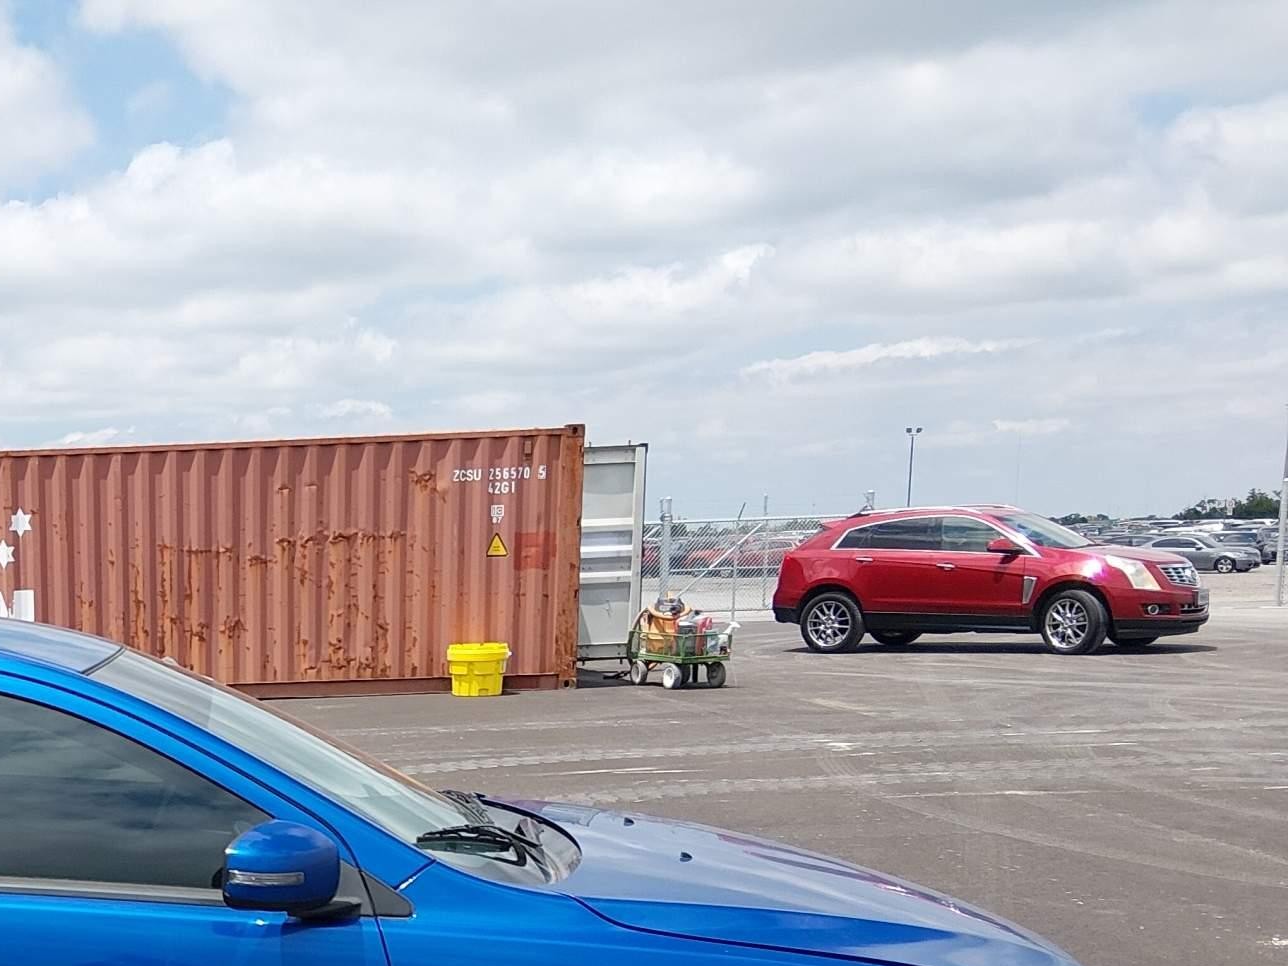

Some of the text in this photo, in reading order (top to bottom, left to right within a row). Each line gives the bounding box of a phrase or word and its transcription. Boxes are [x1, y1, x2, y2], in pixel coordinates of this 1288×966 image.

[453, 465, 547, 482] ZCSU 256570 5
